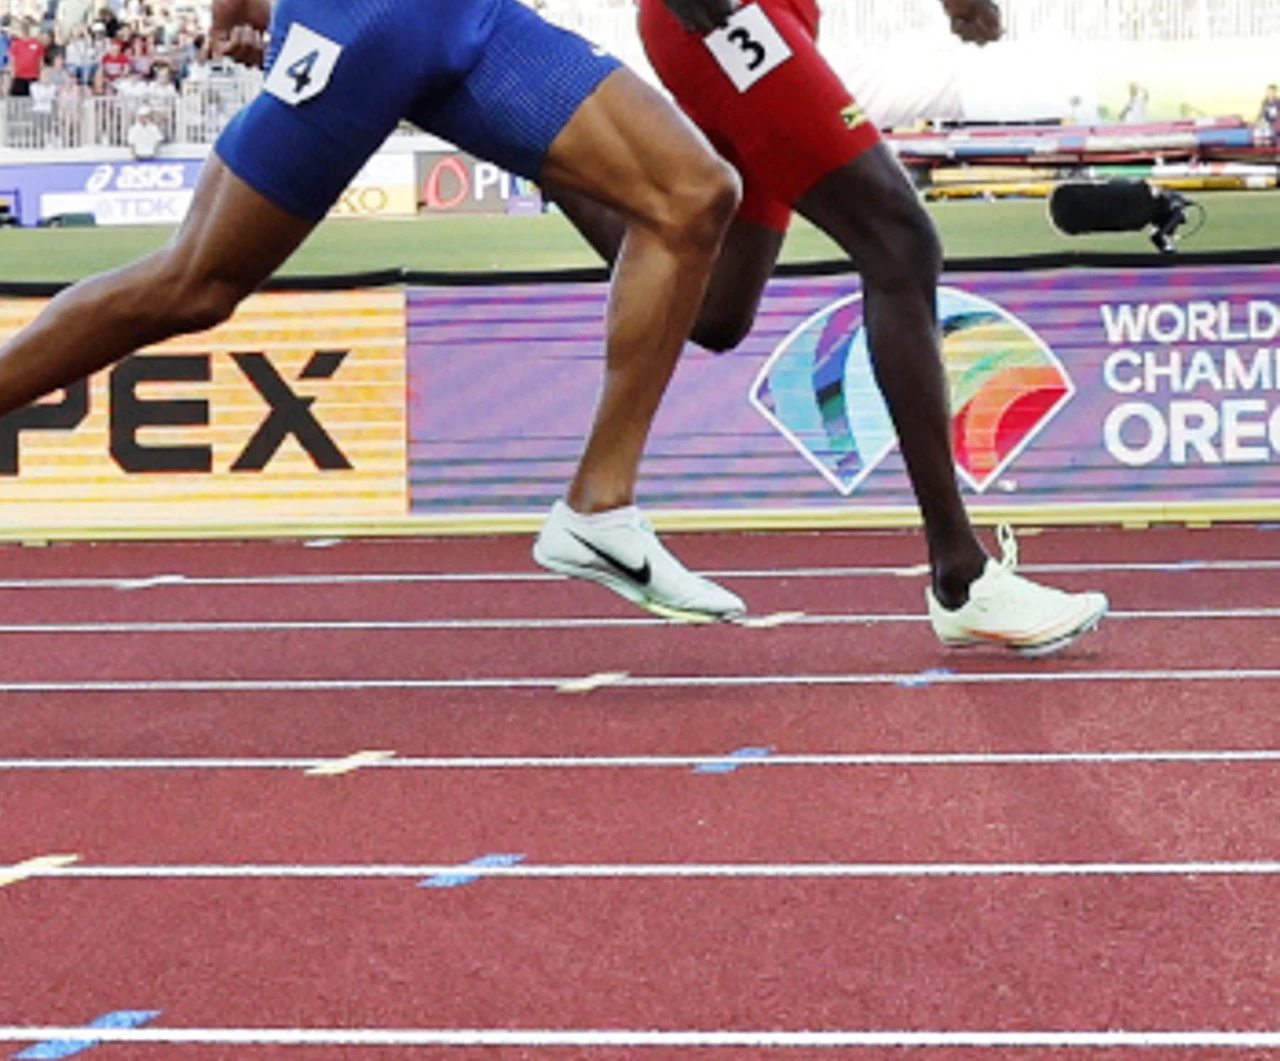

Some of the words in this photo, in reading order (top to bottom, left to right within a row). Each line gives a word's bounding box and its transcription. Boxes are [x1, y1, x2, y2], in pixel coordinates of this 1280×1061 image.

[286, 49, 319, 95] 4
[727, 26, 766, 72] 3
[1100, 300, 1280, 343] WORLD
[1103, 348, 1280, 393] CHAM
[1103, 399, 1280, 466] ORE
